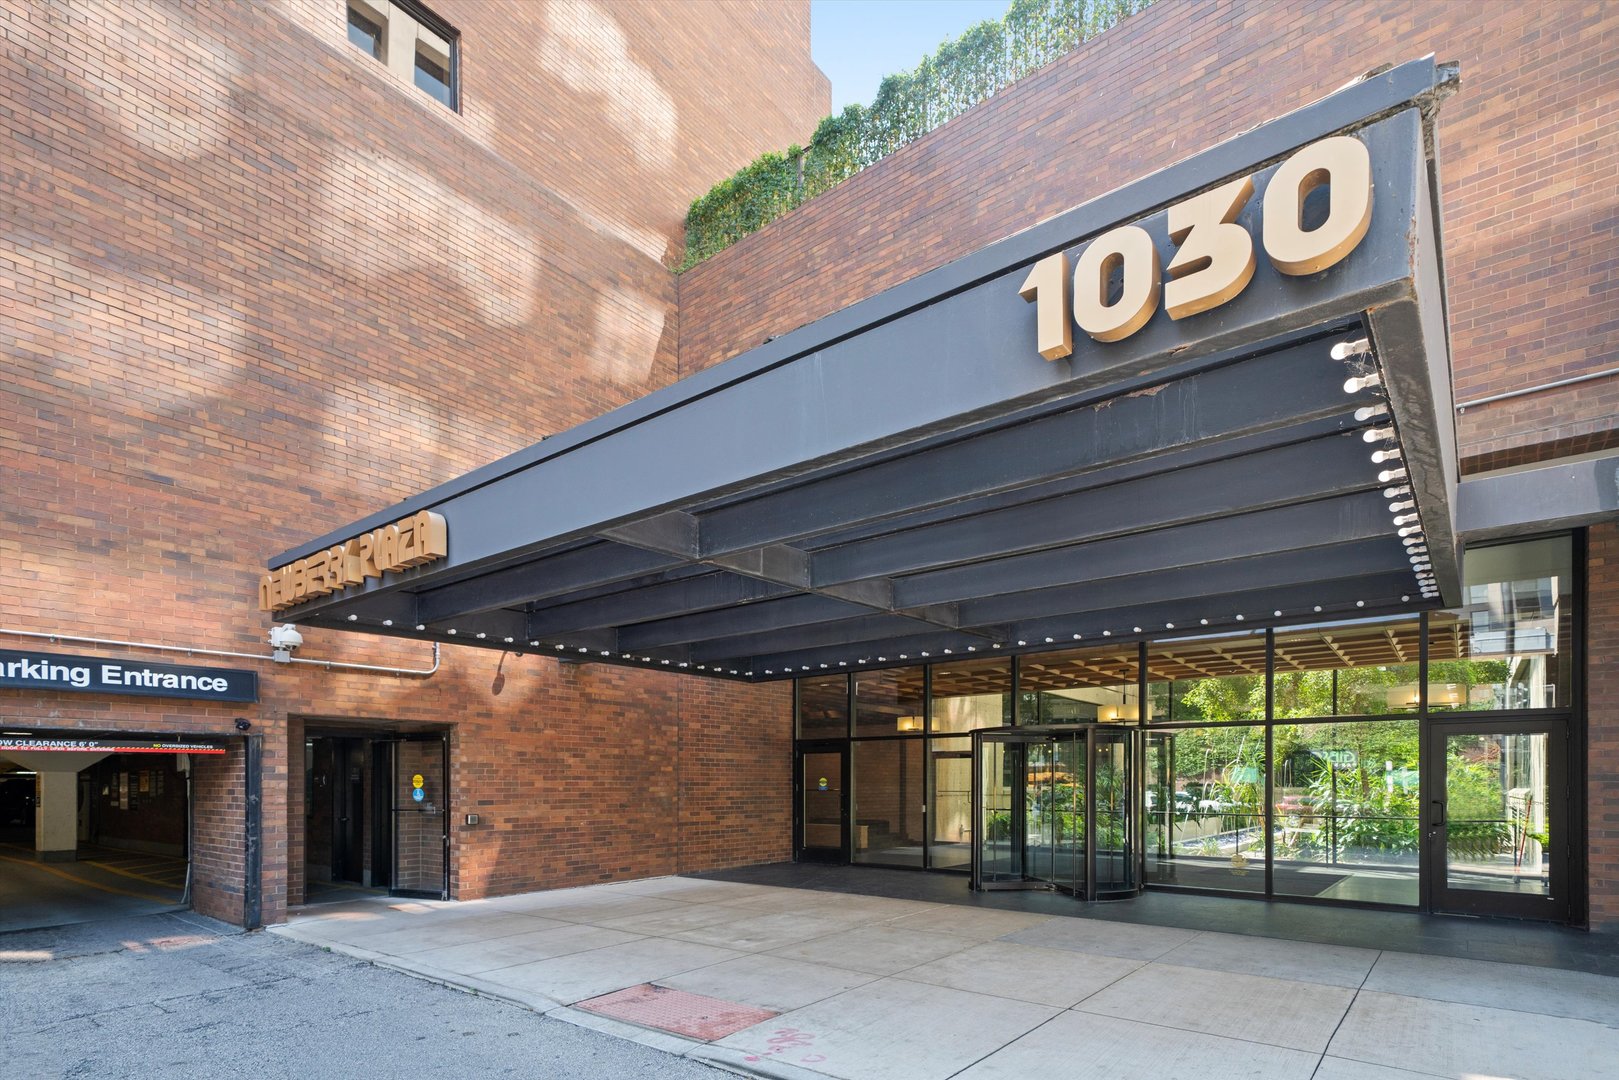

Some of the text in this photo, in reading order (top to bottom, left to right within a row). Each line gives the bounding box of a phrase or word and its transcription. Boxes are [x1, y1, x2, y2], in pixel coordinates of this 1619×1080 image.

[1018, 136, 1373, 360] 1030
[360, 510, 447, 577] PLAZA
[101, 665, 228, 692] Entrance
